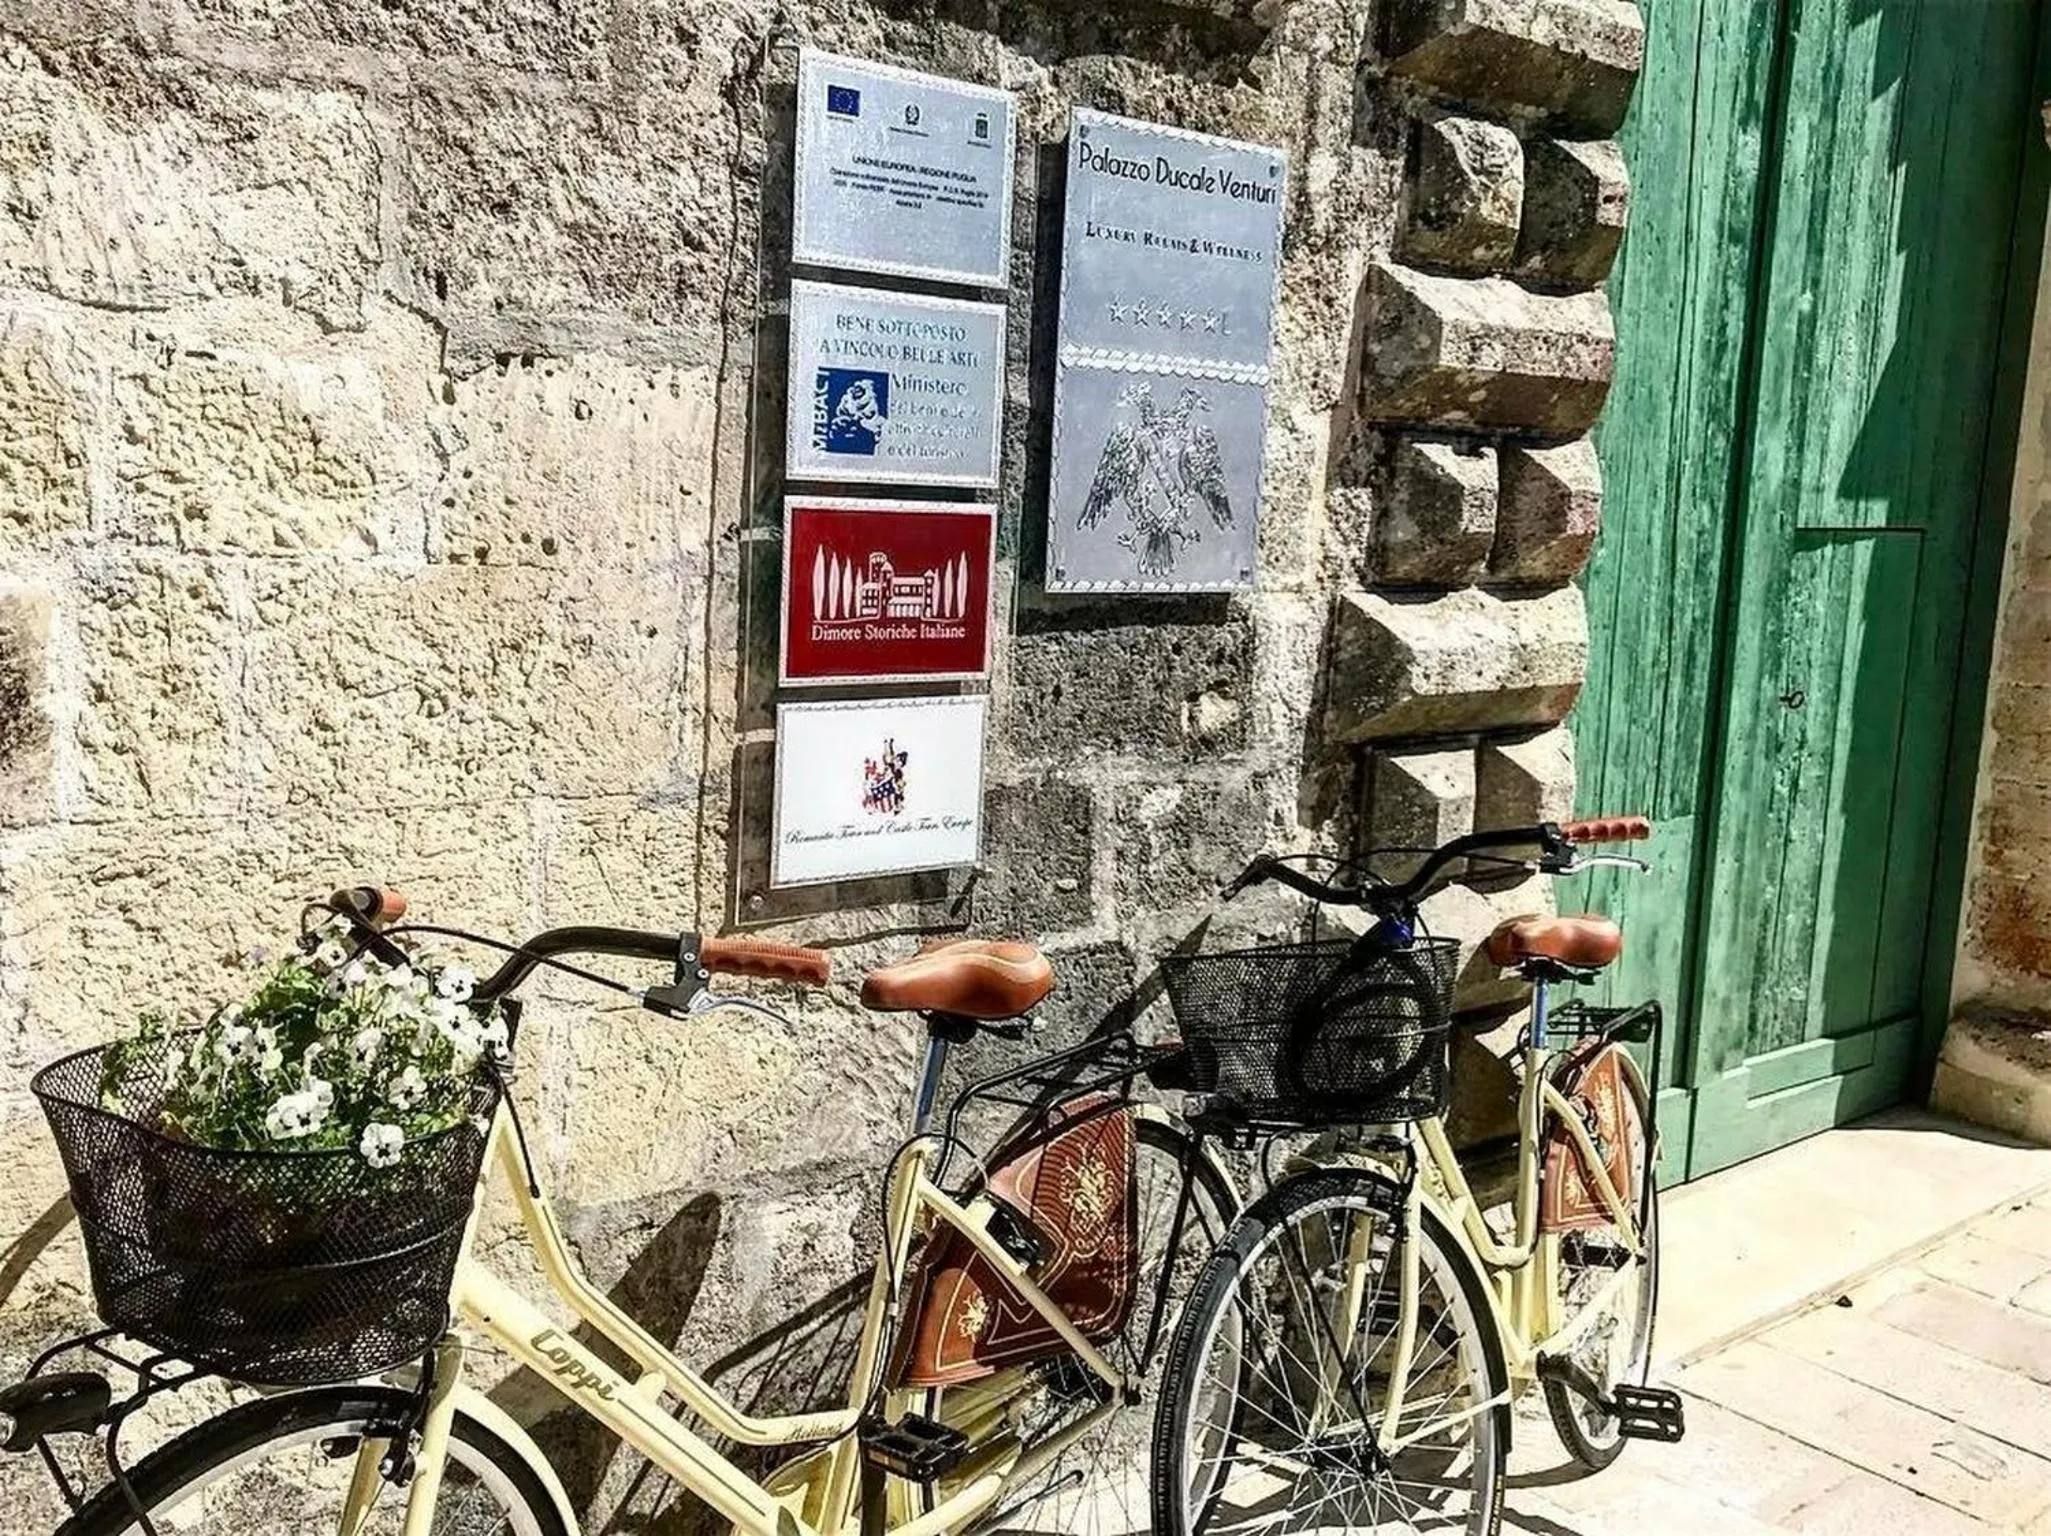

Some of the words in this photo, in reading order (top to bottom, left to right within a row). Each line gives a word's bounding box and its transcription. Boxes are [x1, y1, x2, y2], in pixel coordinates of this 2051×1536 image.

[1079, 142, 1150, 182] Palazzo
[1156, 157, 1215, 194] Ducale
[1219, 169, 1277, 205] Venturi
[836, 314, 873, 332] BENE
[878, 320, 966, 342] SOTTOPOSTO
[832, 340, 899, 358] VINCOLO
[903, 345, 945, 365] BELLE
[892, 373, 967, 396] Ministero
[812, 624, 861, 642] Dimore
[865, 623, 917, 641] Storiche
[920, 623, 966, 640] Italiane
[531, 1328, 619, 1402] Coppi
